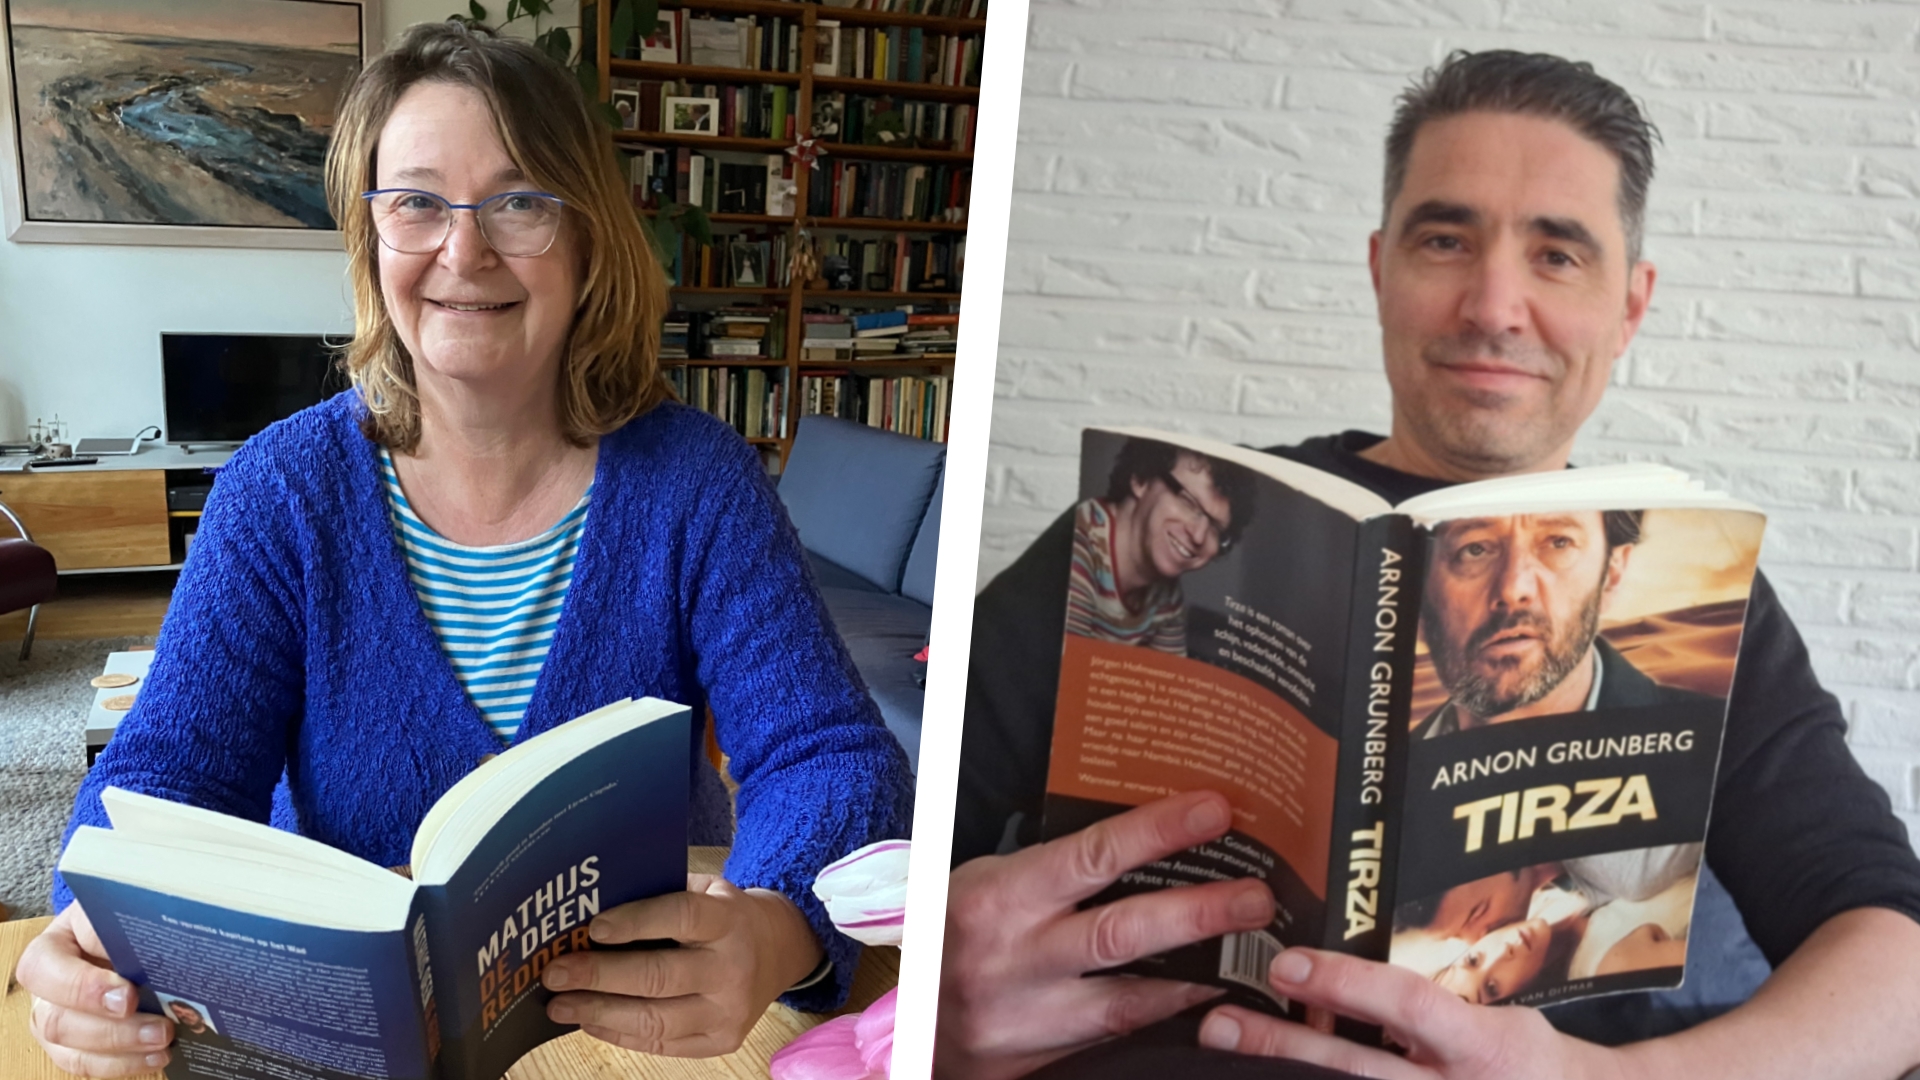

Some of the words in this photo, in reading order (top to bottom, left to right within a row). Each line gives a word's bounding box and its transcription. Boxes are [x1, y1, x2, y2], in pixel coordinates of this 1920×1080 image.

[1224, 595, 1246, 613] Tirza
[1247, 605, 1254, 617] is
[1256, 612, 1270, 625] een
[1272, 620, 1295, 640] roman
[1296, 635, 1312, 651] over
[1373, 547, 1403, 653] ARNON
[1218, 647, 1231, 658] en
[1228, 614, 1243, 630] het
[1285, 646, 1297, 660] van
[1298, 654, 1307, 667] de
[1360, 660, 1393, 805] GRUNBERG
[1430, 746, 1537, 791] ARNON
[1546, 729, 1695, 764] GRUNBERG
[1452, 773, 1658, 854] TIRZA
[1199, 845, 1267, 879] Literatuurprijs
[1224, 835, 1261, 860] Gouden
[1262, 853, 1275, 869] Uil
[1343, 820, 1384, 942] TIRZA
[161, 913, 179, 926] Een
[256, 938, 269, 947] op
[269, 940, 286, 952] het
[477, 855, 600, 977] MATHIJS
[521, 887, 600, 960] DEEN
[480, 950, 511, 1005] DE
[482, 925, 592, 1031] REDDER
[1520, 991, 1545, 1004] VAN
[1548, 980, 1594, 997] DITMAR
